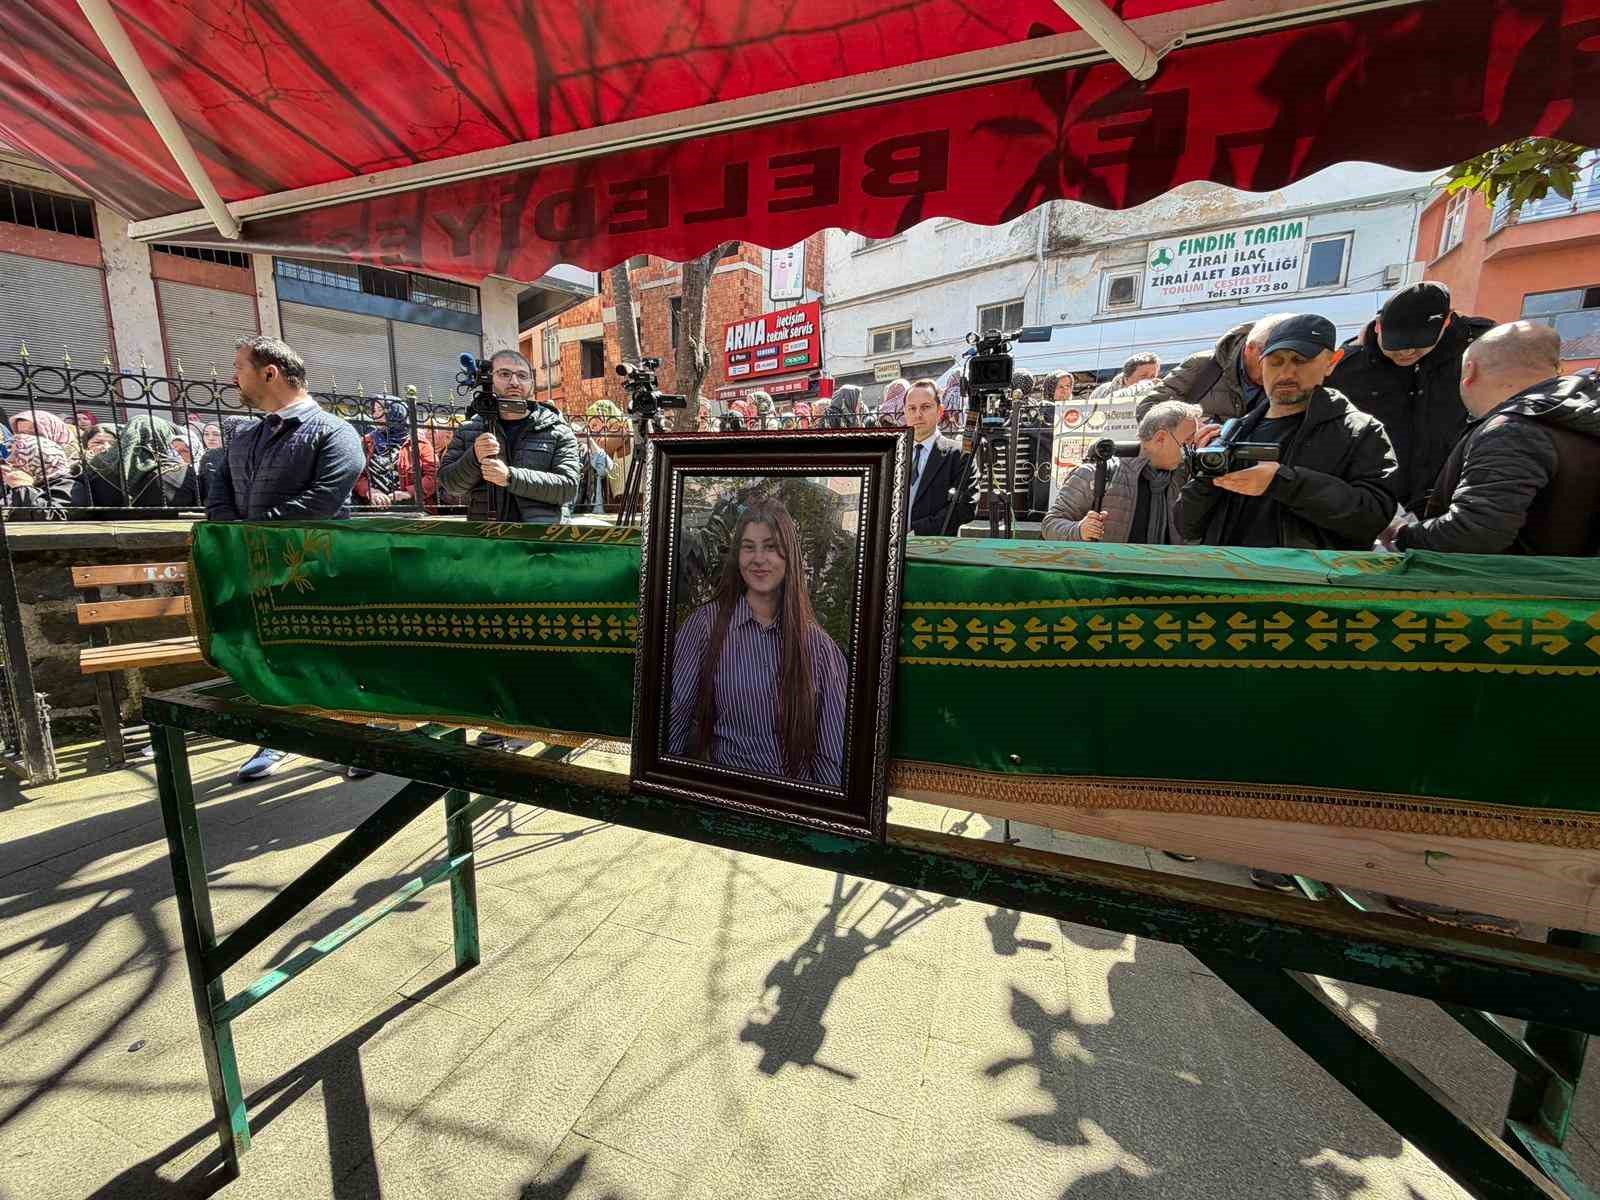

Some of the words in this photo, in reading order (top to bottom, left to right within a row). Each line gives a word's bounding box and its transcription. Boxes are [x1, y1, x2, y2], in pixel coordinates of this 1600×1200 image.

[1178, 232, 1236, 255] FINDIK
[1244, 221, 1303, 247] TARIM
[1151, 270, 1189, 287] ZİRAİ
[1192, 269, 1226, 283] ALET
[1231, 255, 1298, 277] BAYİLİĞİ
[1188, 250, 1228, 269] ZİRAİ
[1233, 247, 1266, 264] İLAÇ
[1230, 286, 1250, 296] 513
[725, 318, 766, 353] ARMA
[790, 320, 813, 338] servis
